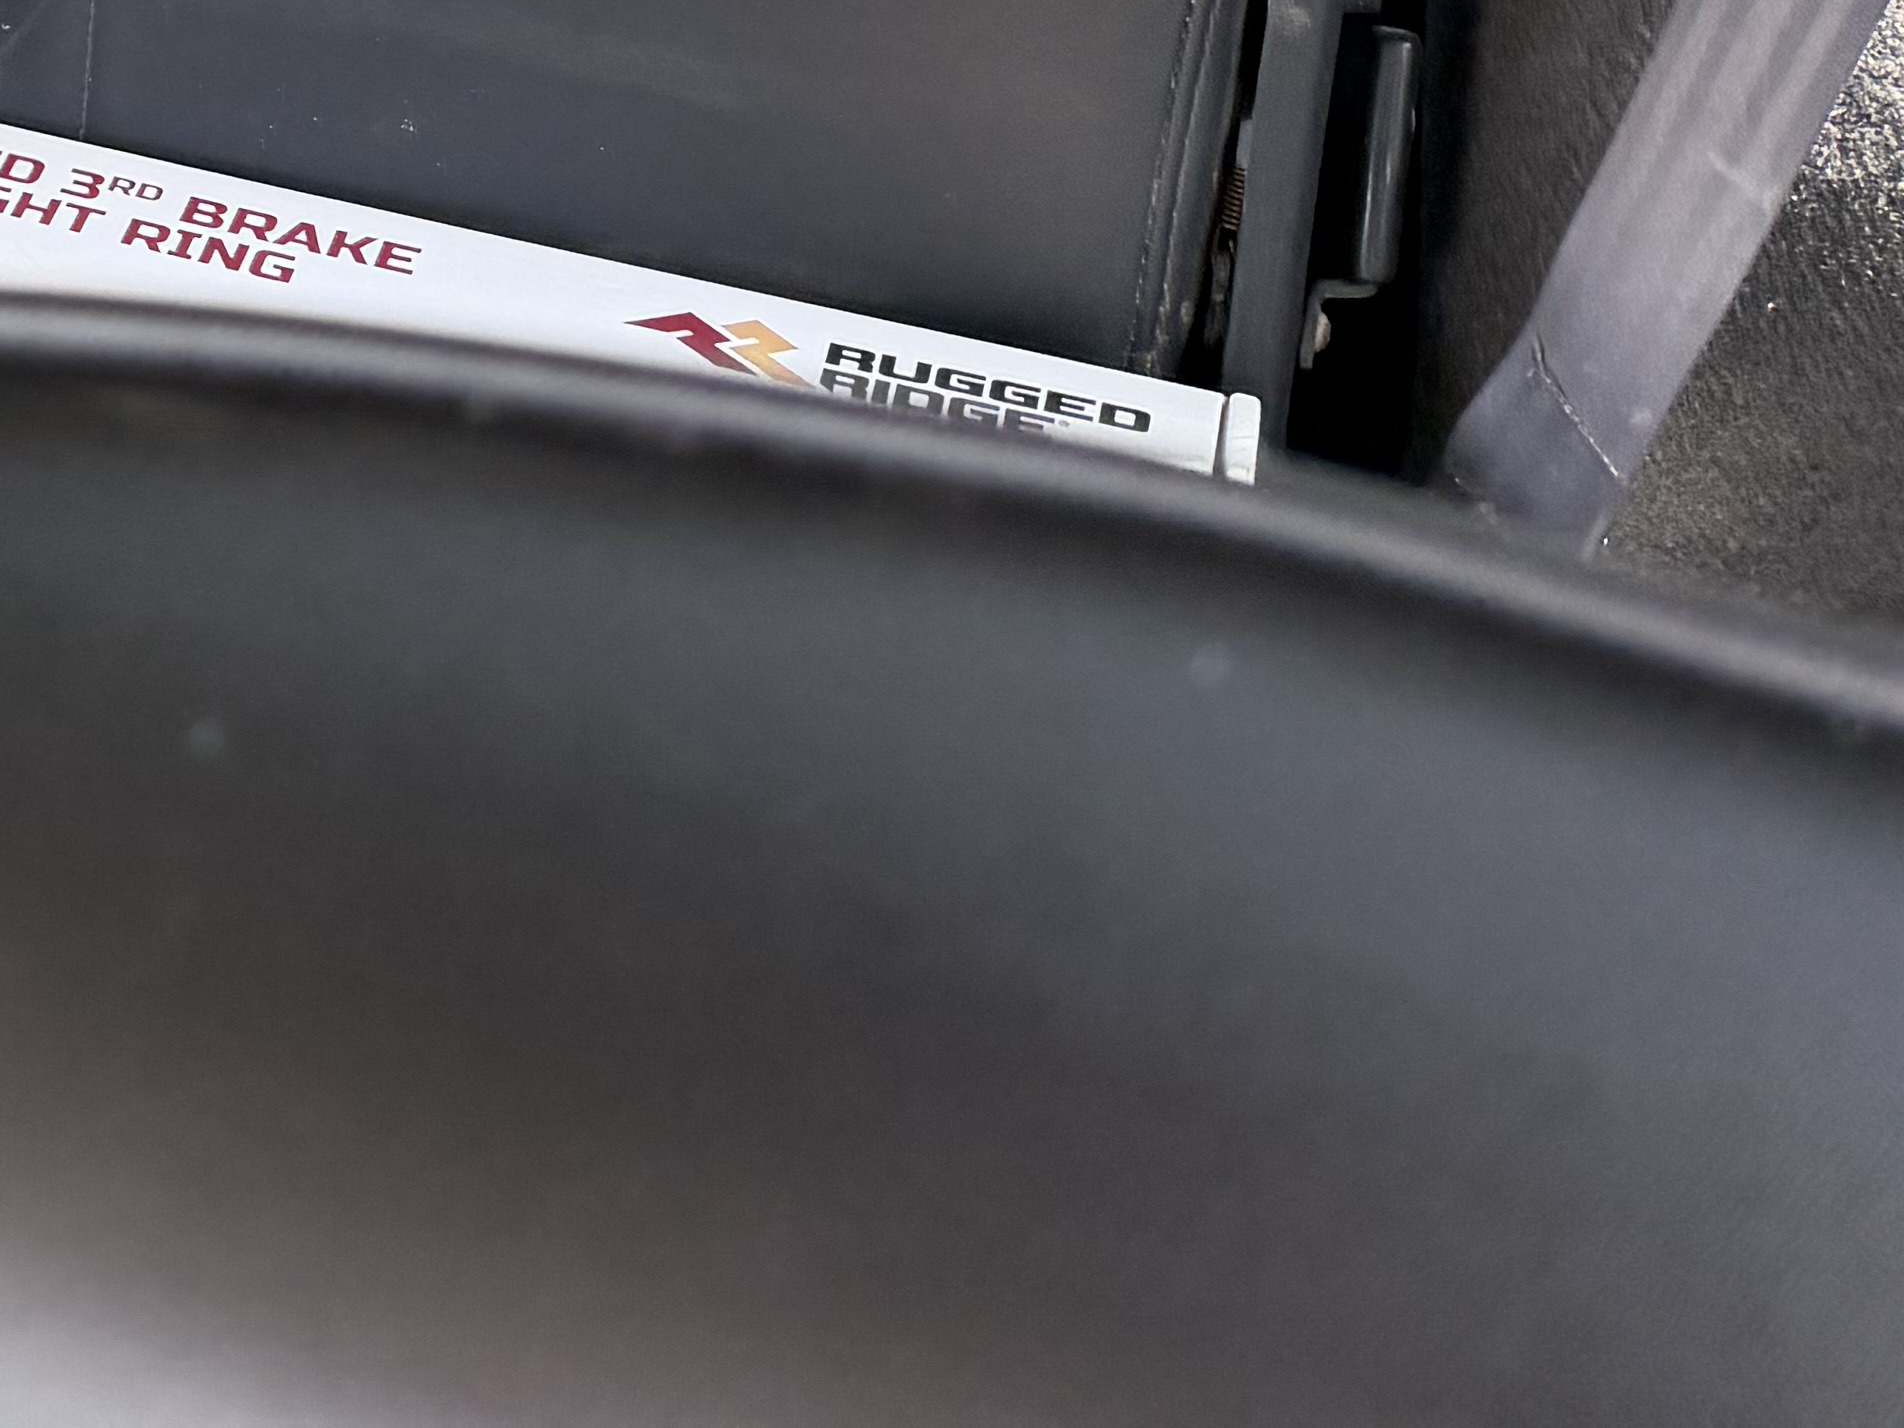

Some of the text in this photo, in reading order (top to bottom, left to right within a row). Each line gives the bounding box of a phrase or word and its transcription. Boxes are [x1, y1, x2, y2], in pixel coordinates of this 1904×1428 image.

[60, 167, 165, 202] 3RD
[179, 196, 423, 275] BRAKE
[120, 218, 297, 283] RING
[823, 341, 1152, 433] RUGGED
